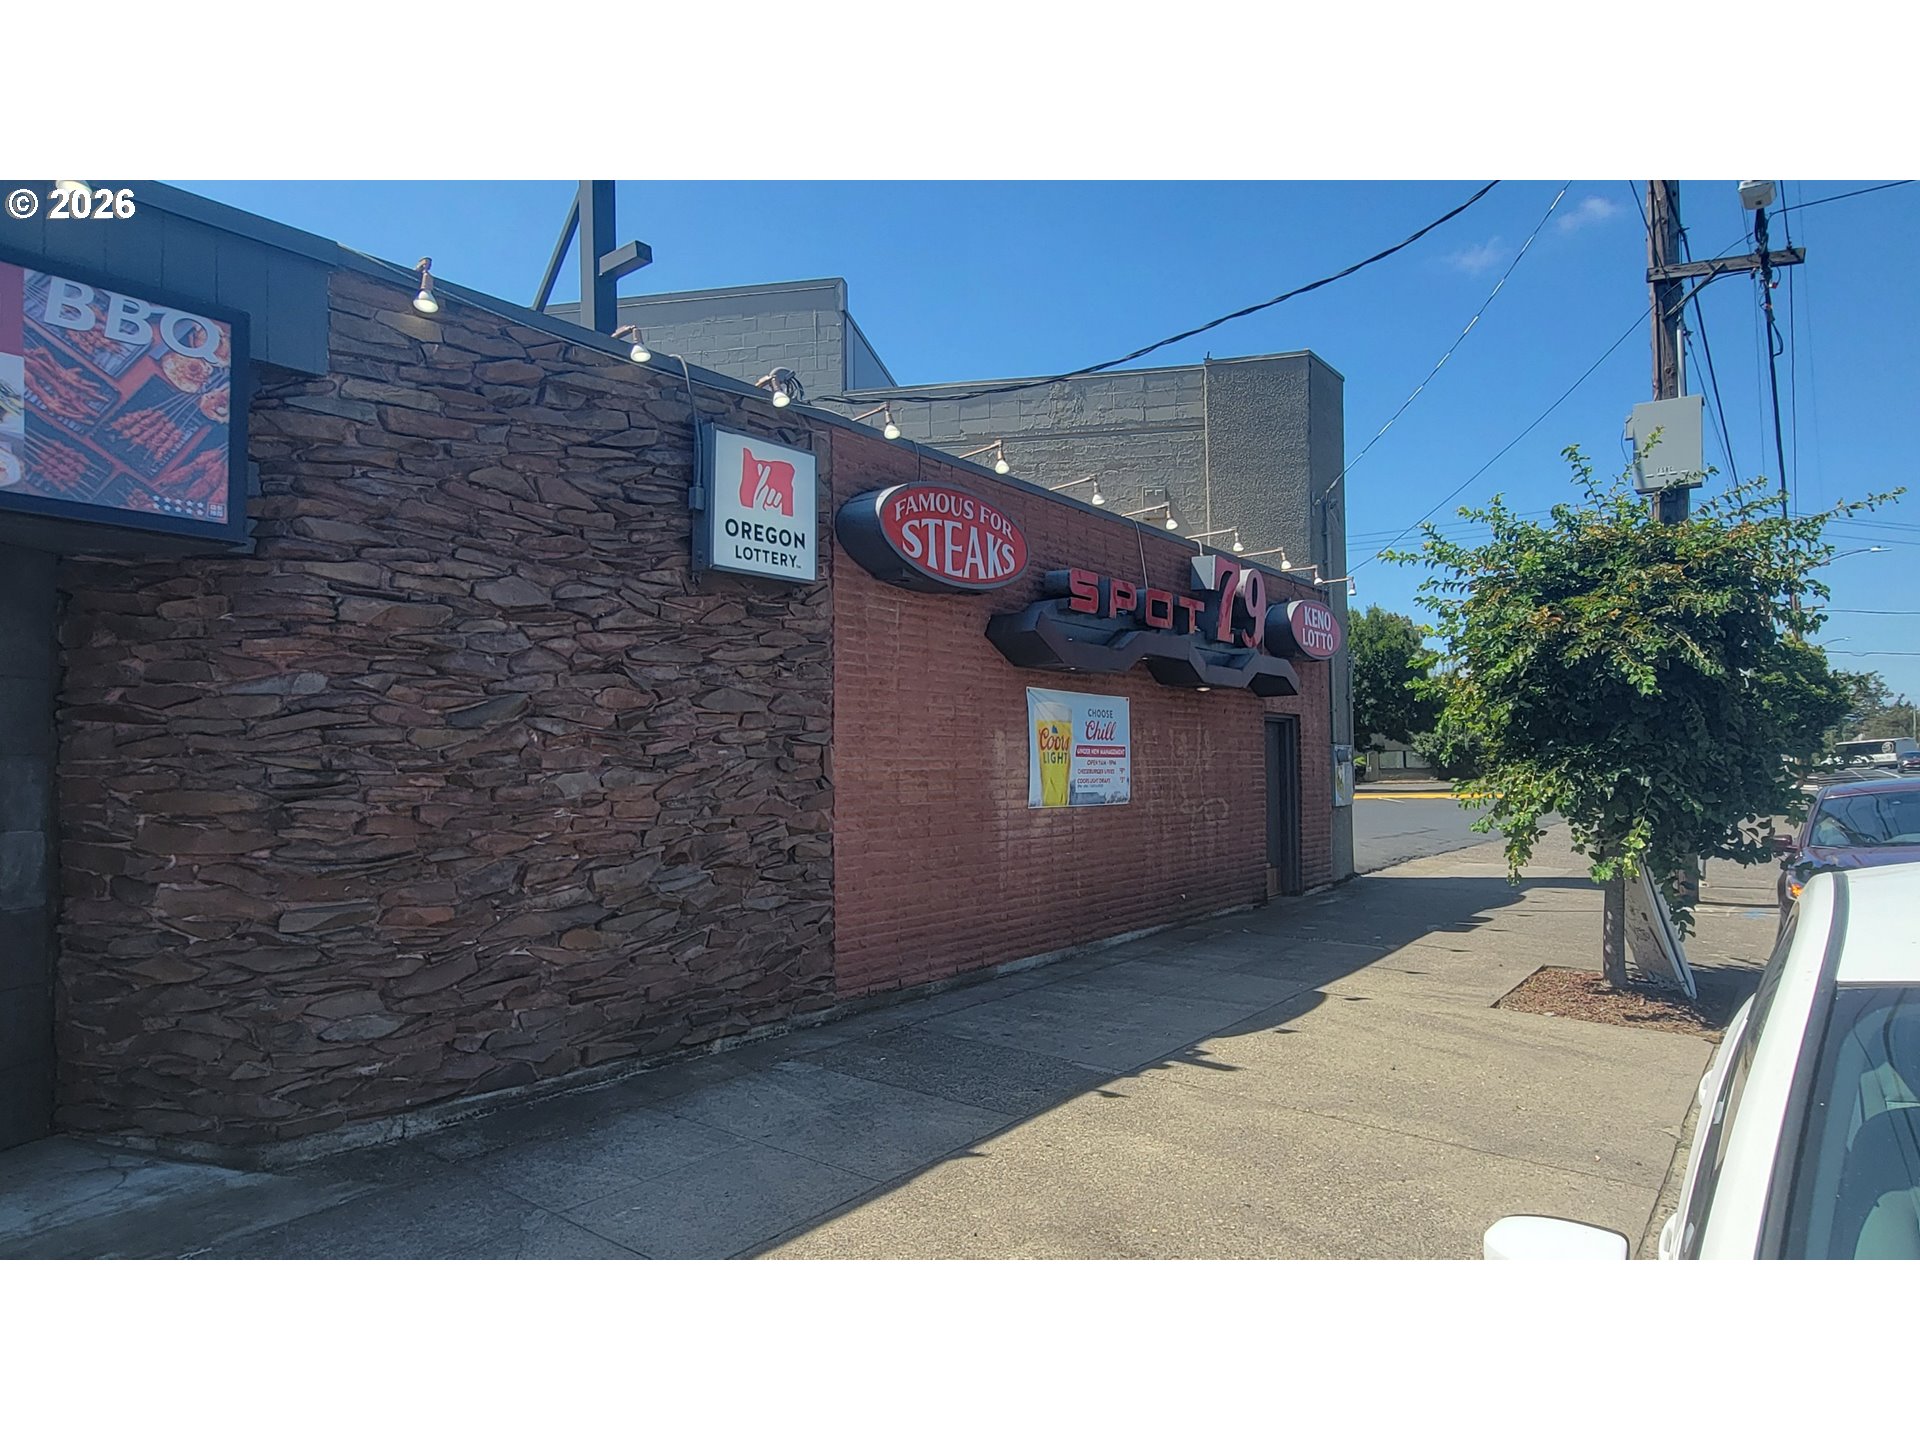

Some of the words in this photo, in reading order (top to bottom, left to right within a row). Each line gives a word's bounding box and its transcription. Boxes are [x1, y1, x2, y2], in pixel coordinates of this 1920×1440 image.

[44, 278, 221, 365] BBQ
[894, 492, 974, 522] FAMOUS
[979, 505, 1015, 543] FOR
[725, 518, 806, 550] OREGON
[735, 545, 798, 568] LOTTERY
[901, 518, 1016, 580] STEAKS
[1069, 568, 1205, 635] SPOT
[1214, 555, 1267, 648] 79
[1303, 606, 1332, 631] KENO
[1302, 628, 1334, 651] LOTTO
[1087, 708, 1114, 719] CHOOSE
[1038, 727, 1071, 751] Coors
[1085, 720, 1116, 741] Chill
[1042, 752, 1068, 764] LIGHT
